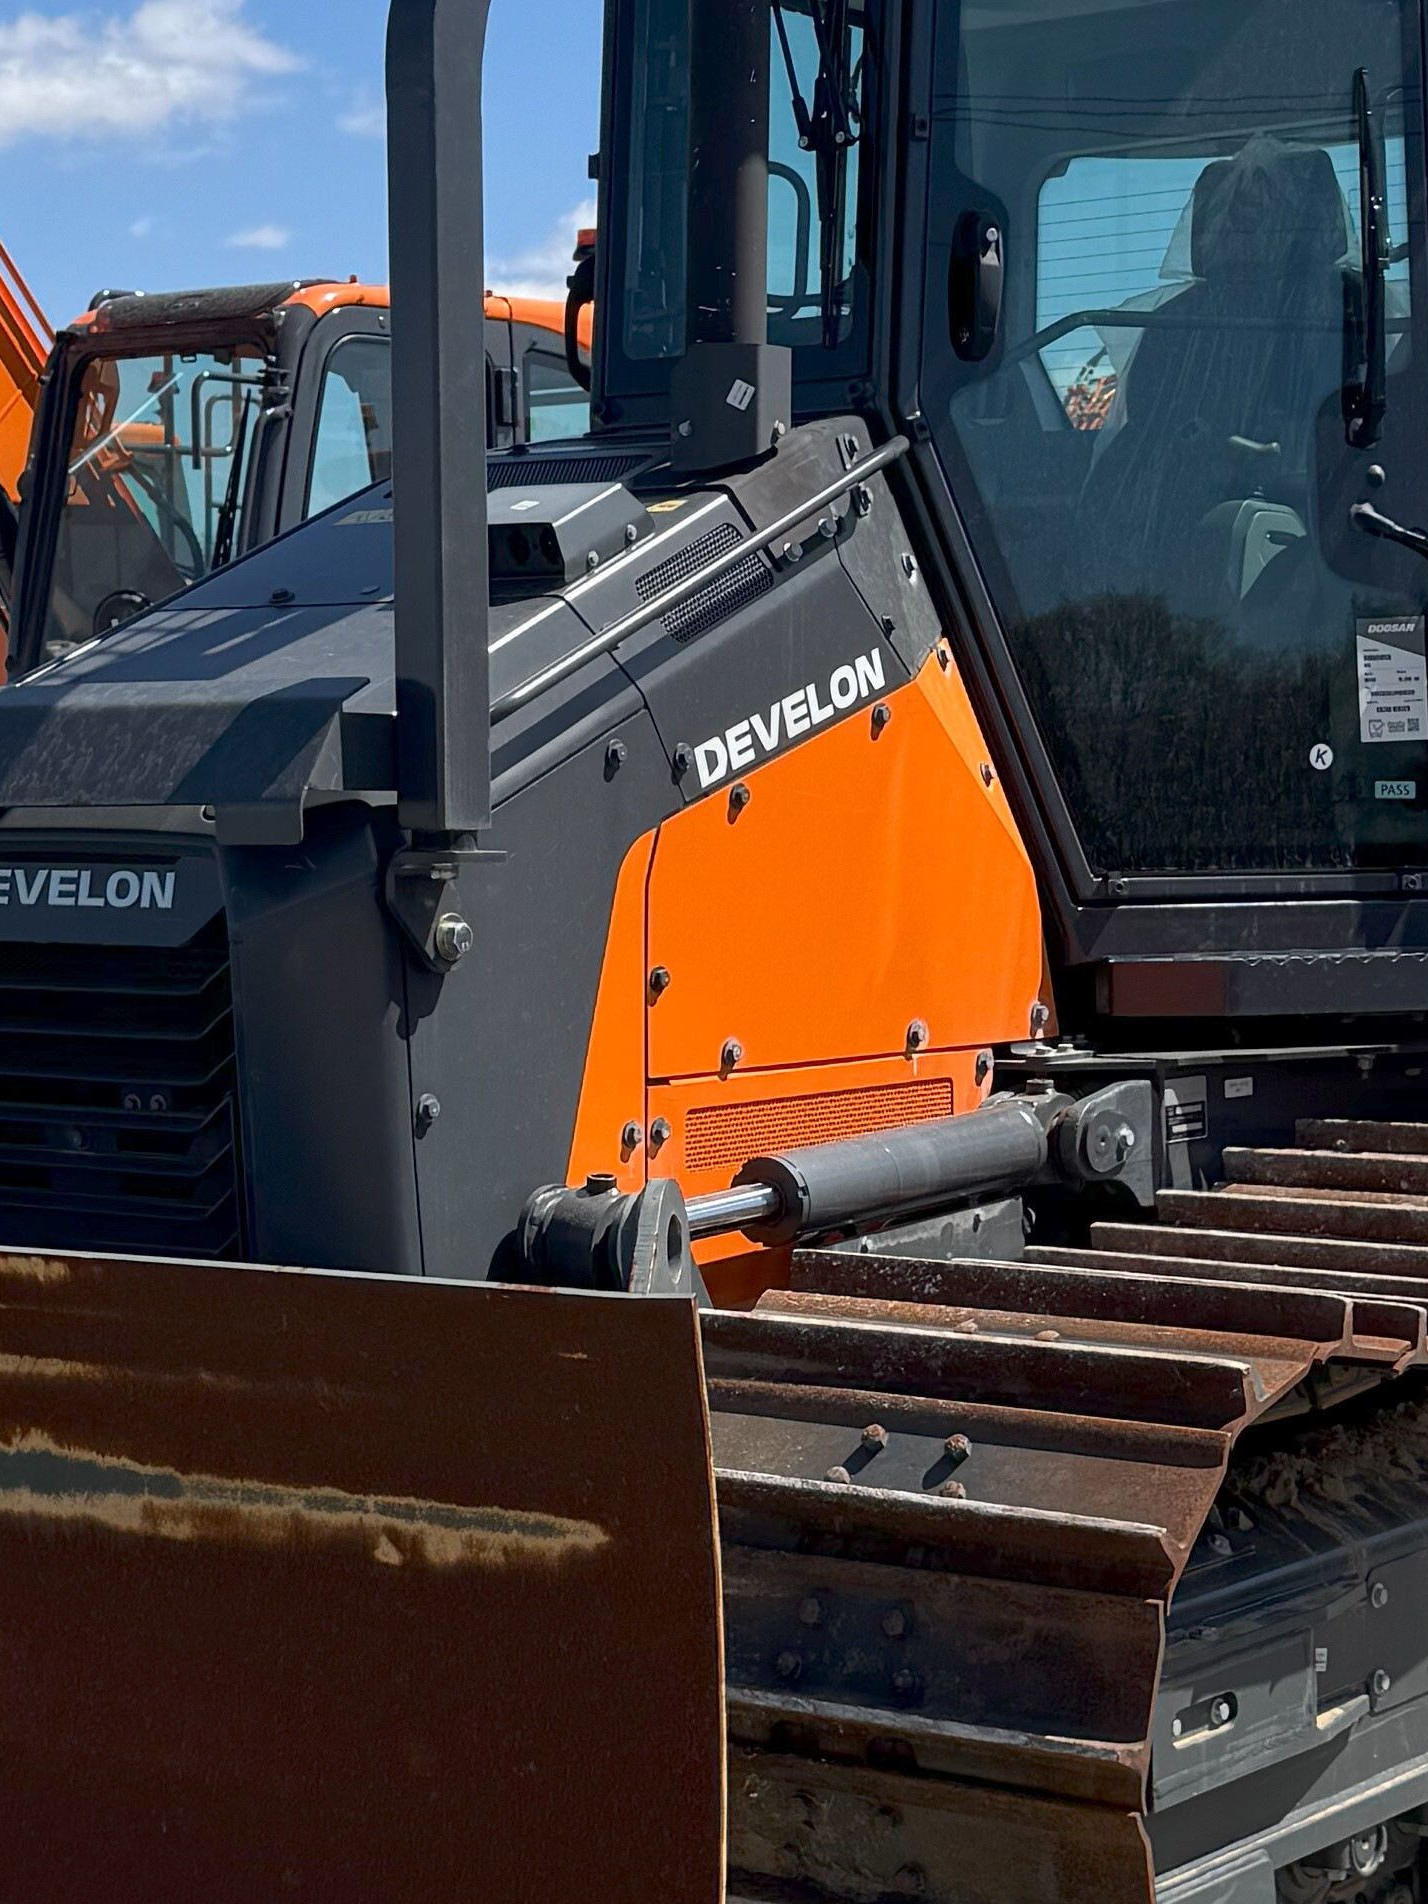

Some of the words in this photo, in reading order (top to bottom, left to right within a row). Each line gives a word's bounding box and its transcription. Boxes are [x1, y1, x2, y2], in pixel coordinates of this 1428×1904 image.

[1367, 623, 1416, 634] DOOSAN
[693, 647, 886, 789] DEVELON
[1314, 747, 1328, 766] K
[1380, 783, 1411, 796] PASS
